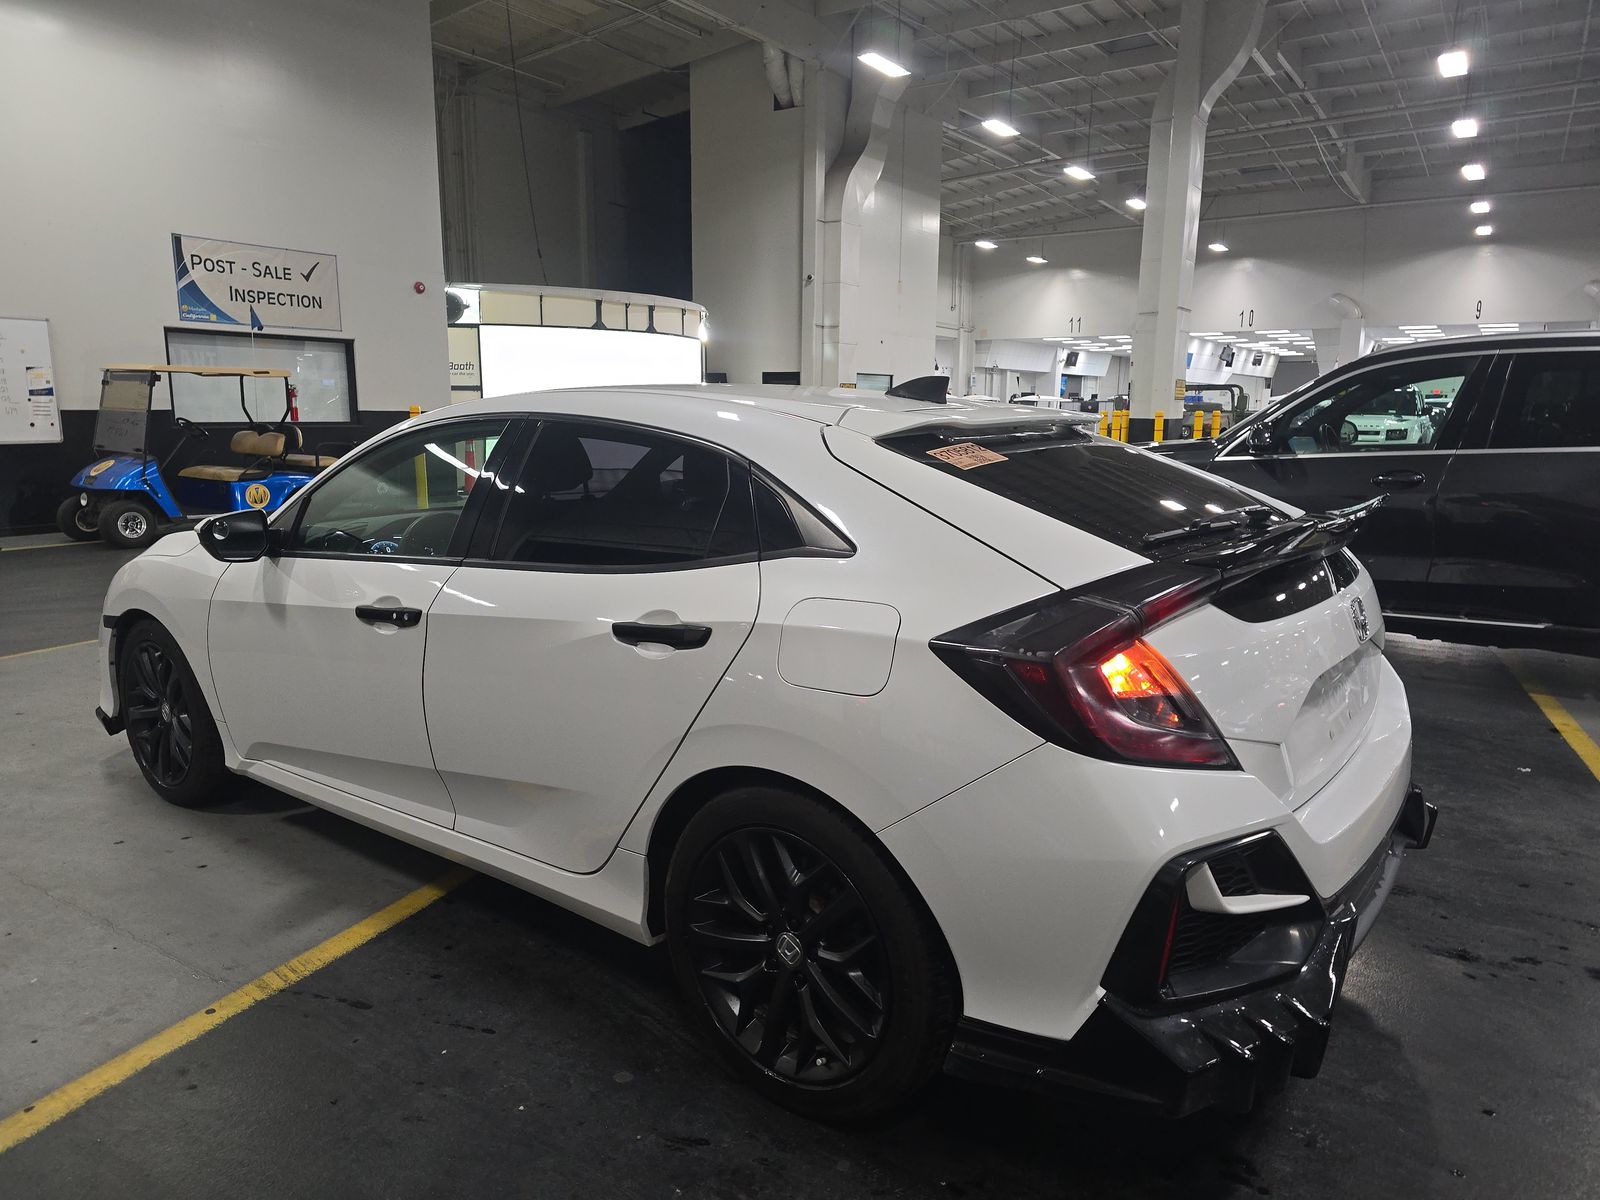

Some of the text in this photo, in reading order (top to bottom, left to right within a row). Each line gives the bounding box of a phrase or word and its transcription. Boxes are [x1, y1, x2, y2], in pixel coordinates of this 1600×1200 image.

[190, 253, 236, 275] POST
[252, 261, 292, 281] SALE
[229, 285, 323, 310] INSPECTION
[1239, 309, 1254, 328] 10
[1475, 300, 1482, 320] 9
[1069, 316, 1081, 333] 11
